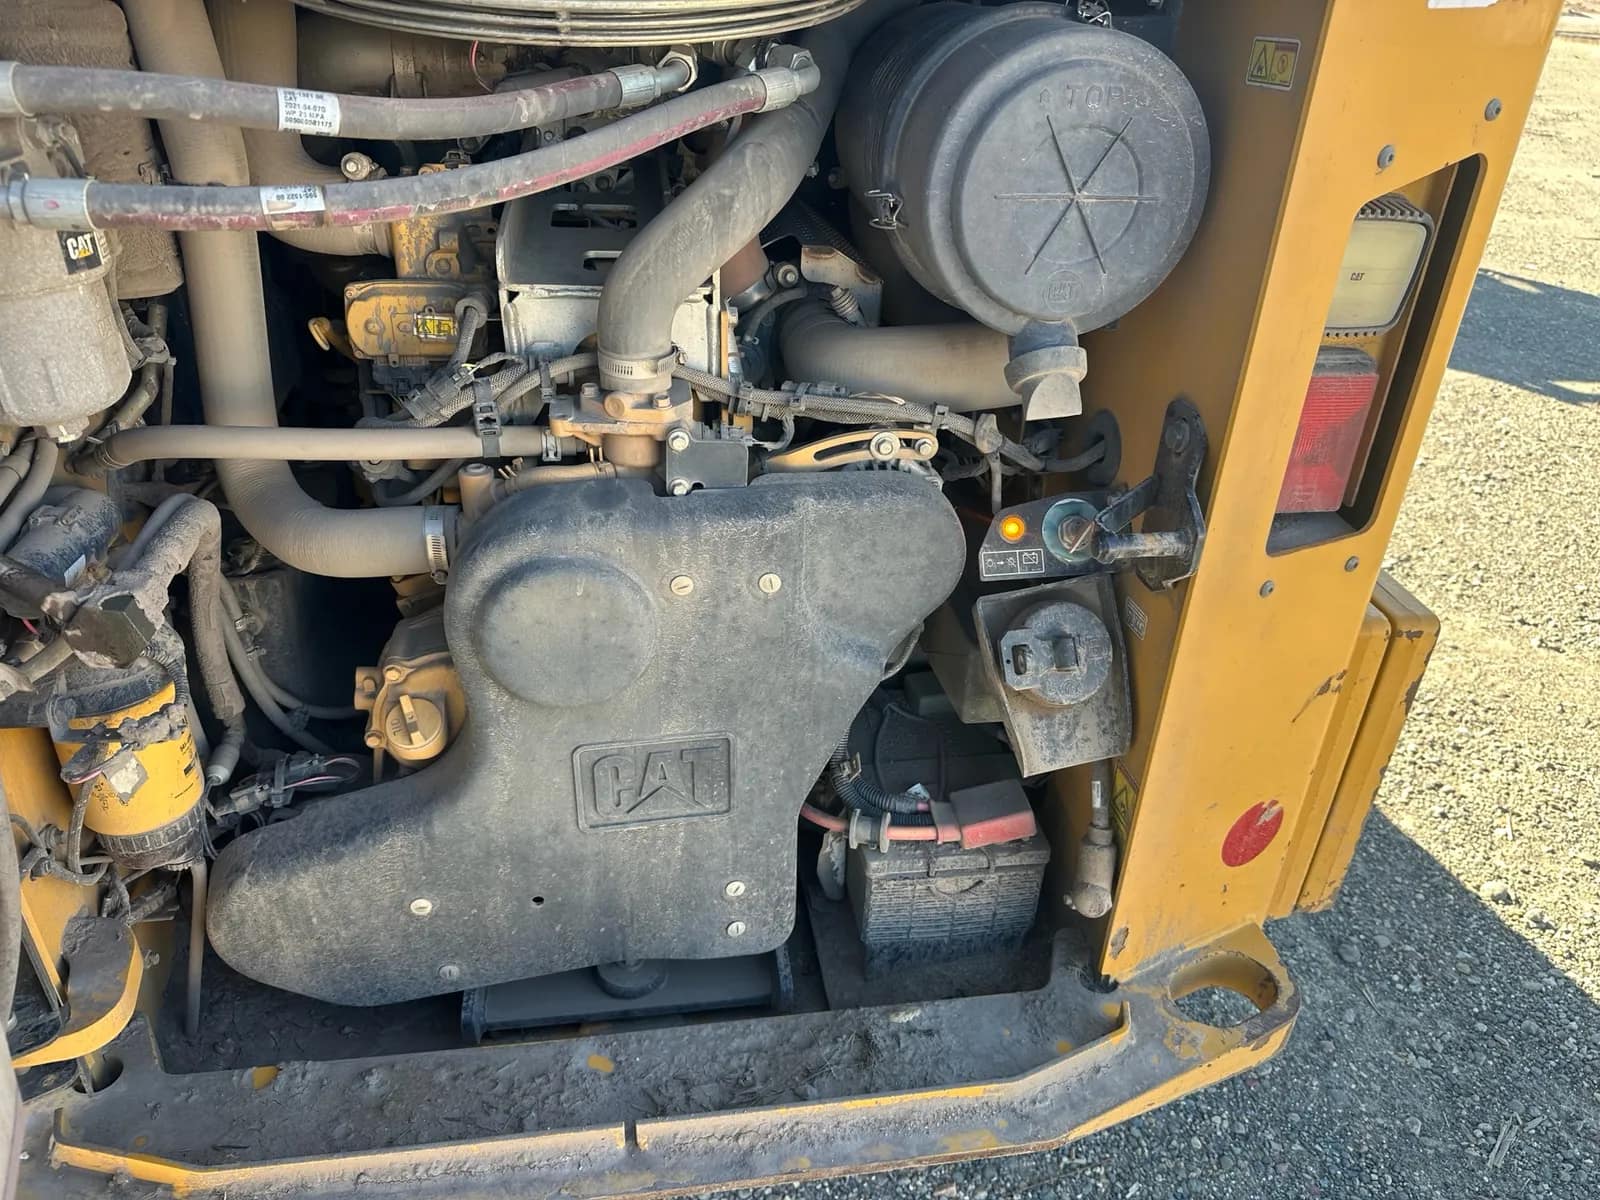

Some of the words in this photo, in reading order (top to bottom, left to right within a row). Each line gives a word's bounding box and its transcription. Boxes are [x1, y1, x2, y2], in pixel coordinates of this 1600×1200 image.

[1065, 84, 1126, 111] TOP
[66, 233, 94, 260] CAT
[1350, 272, 1366, 281] CAT
[592, 746, 720, 818] CAT
